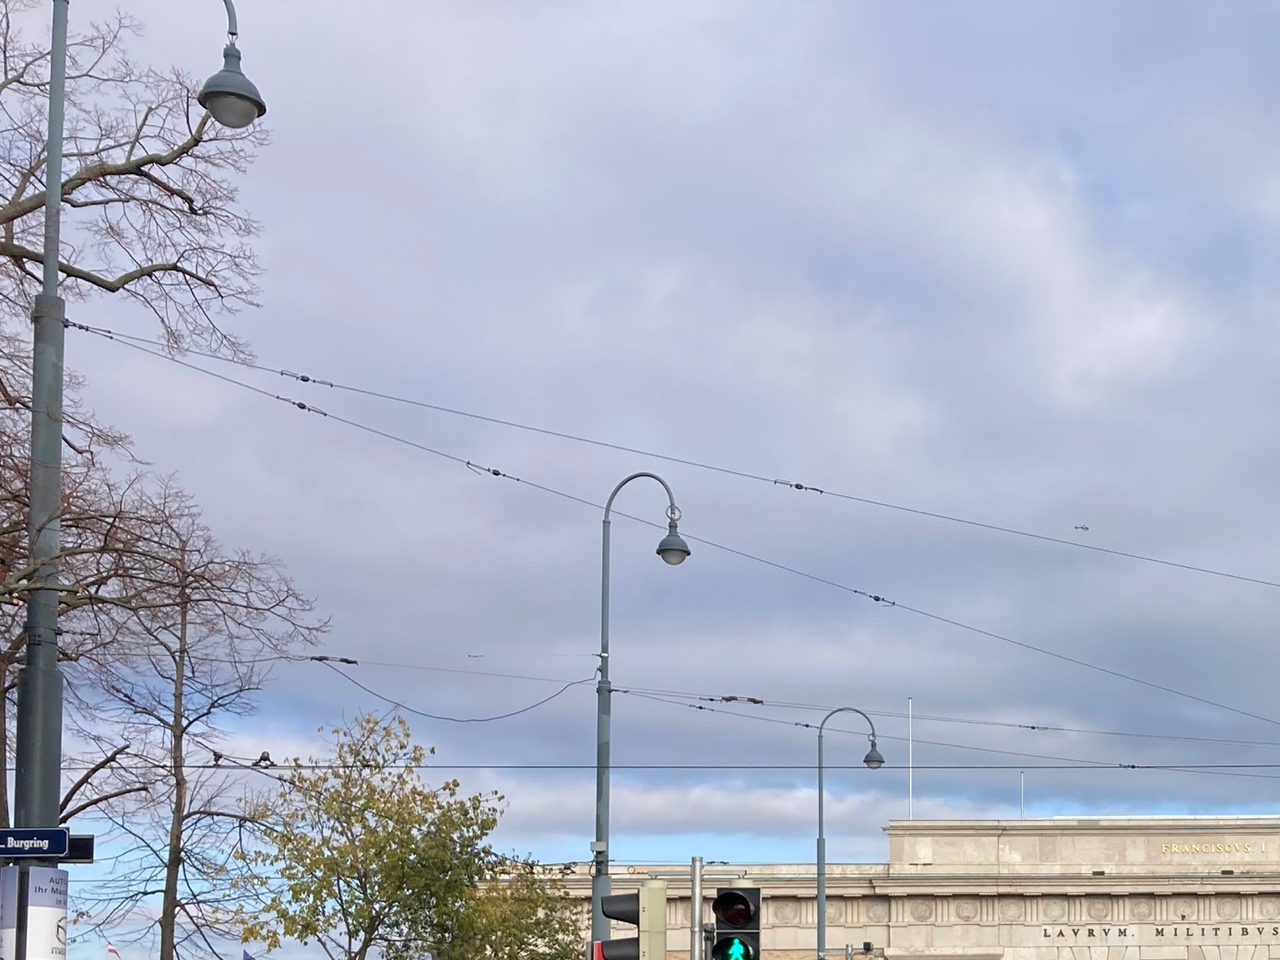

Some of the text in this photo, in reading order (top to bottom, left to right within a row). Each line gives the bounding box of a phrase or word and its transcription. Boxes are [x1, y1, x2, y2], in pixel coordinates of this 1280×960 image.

[7, 836, 49, 850] Burgring
[34, 886, 48, 894] Ihr
[1043, 928, 1136, 938] LAVRVM.
